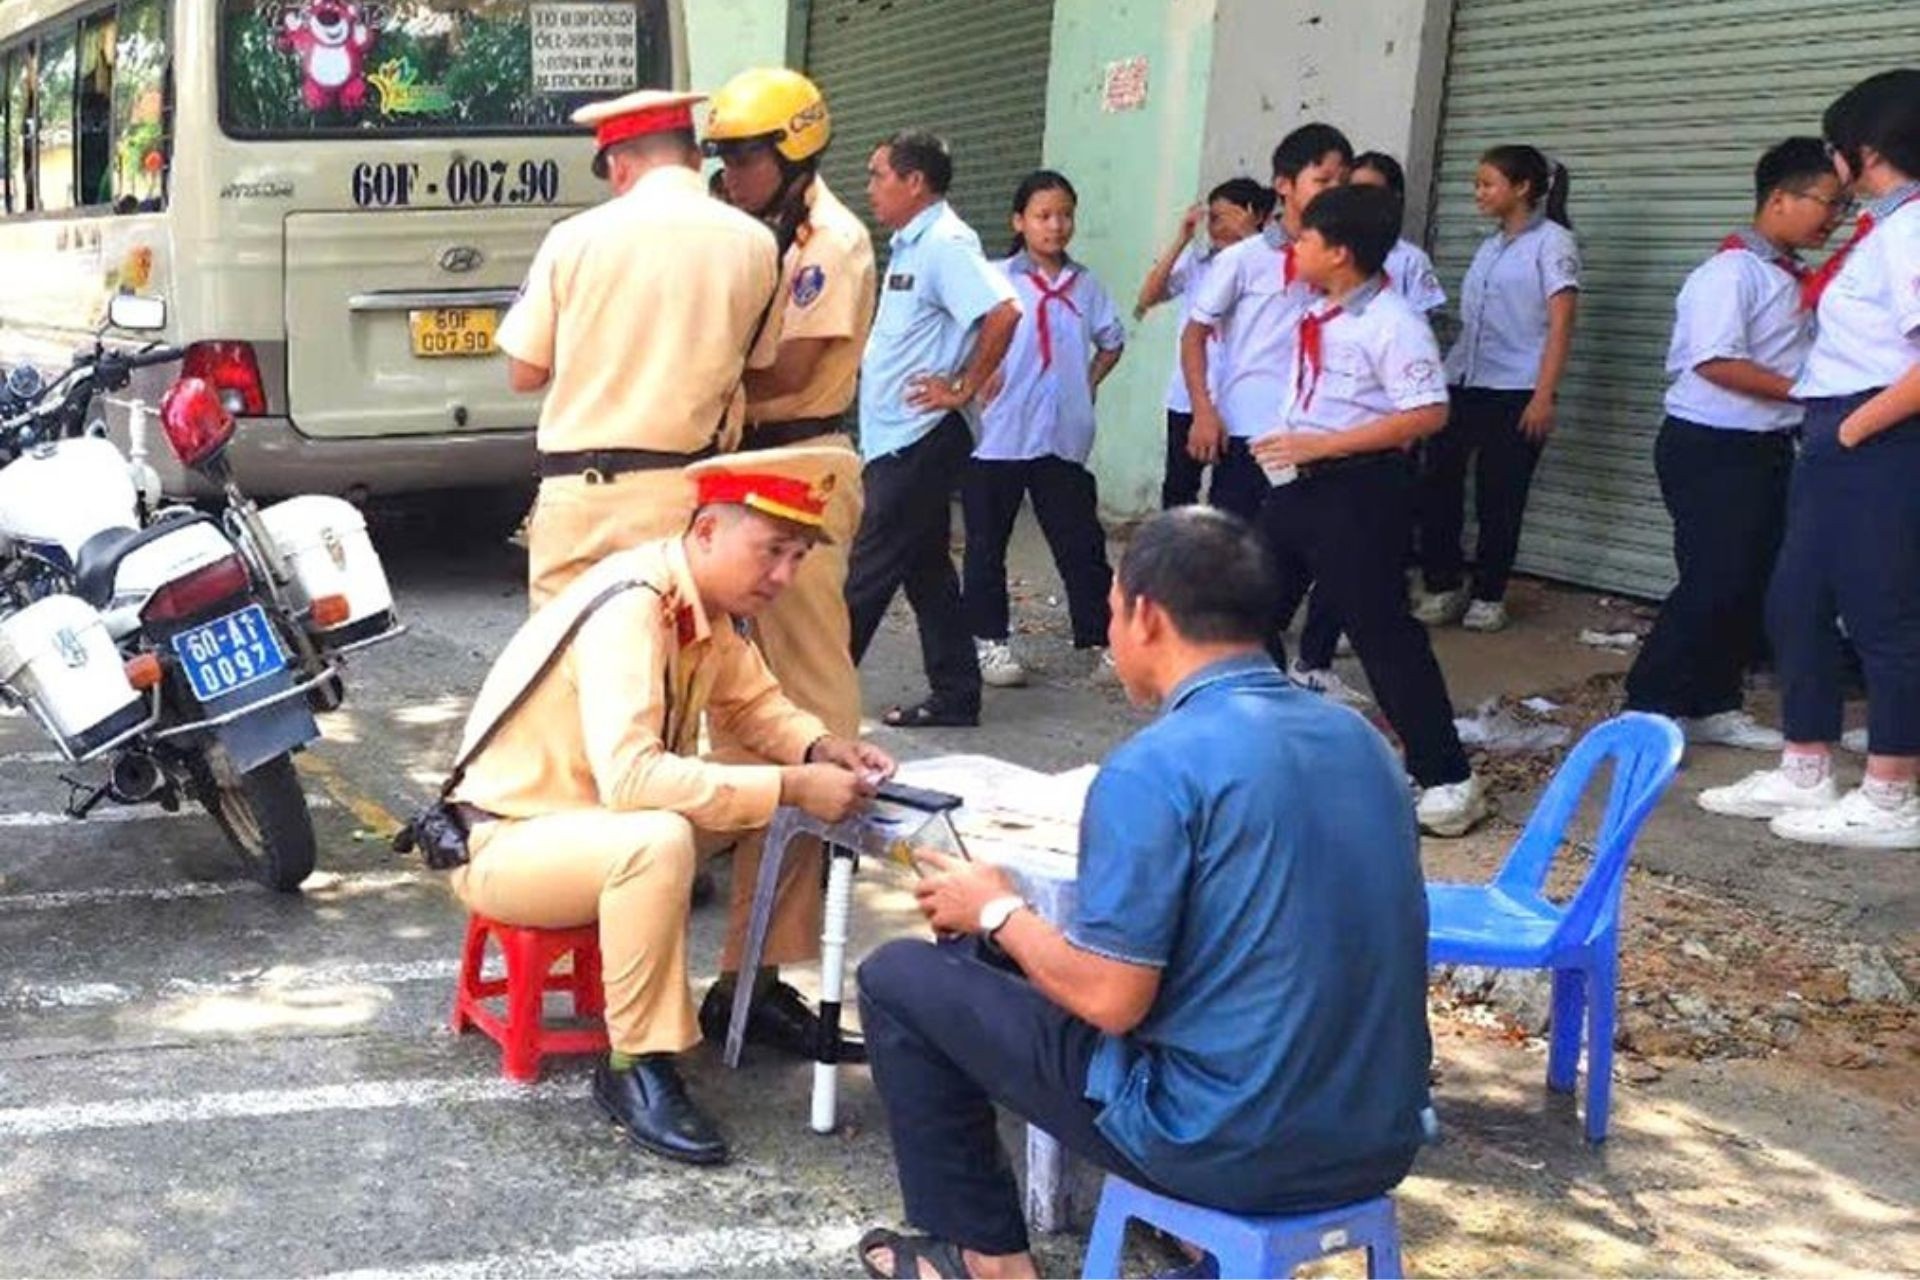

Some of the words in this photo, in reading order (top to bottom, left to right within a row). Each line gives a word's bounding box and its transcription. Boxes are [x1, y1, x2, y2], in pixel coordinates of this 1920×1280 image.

[352, 162, 419, 206] 60F
[446, 159, 560, 204] 007.90
[435, 309, 470, 330] 60F
[200, 642, 266, 692] 0097
